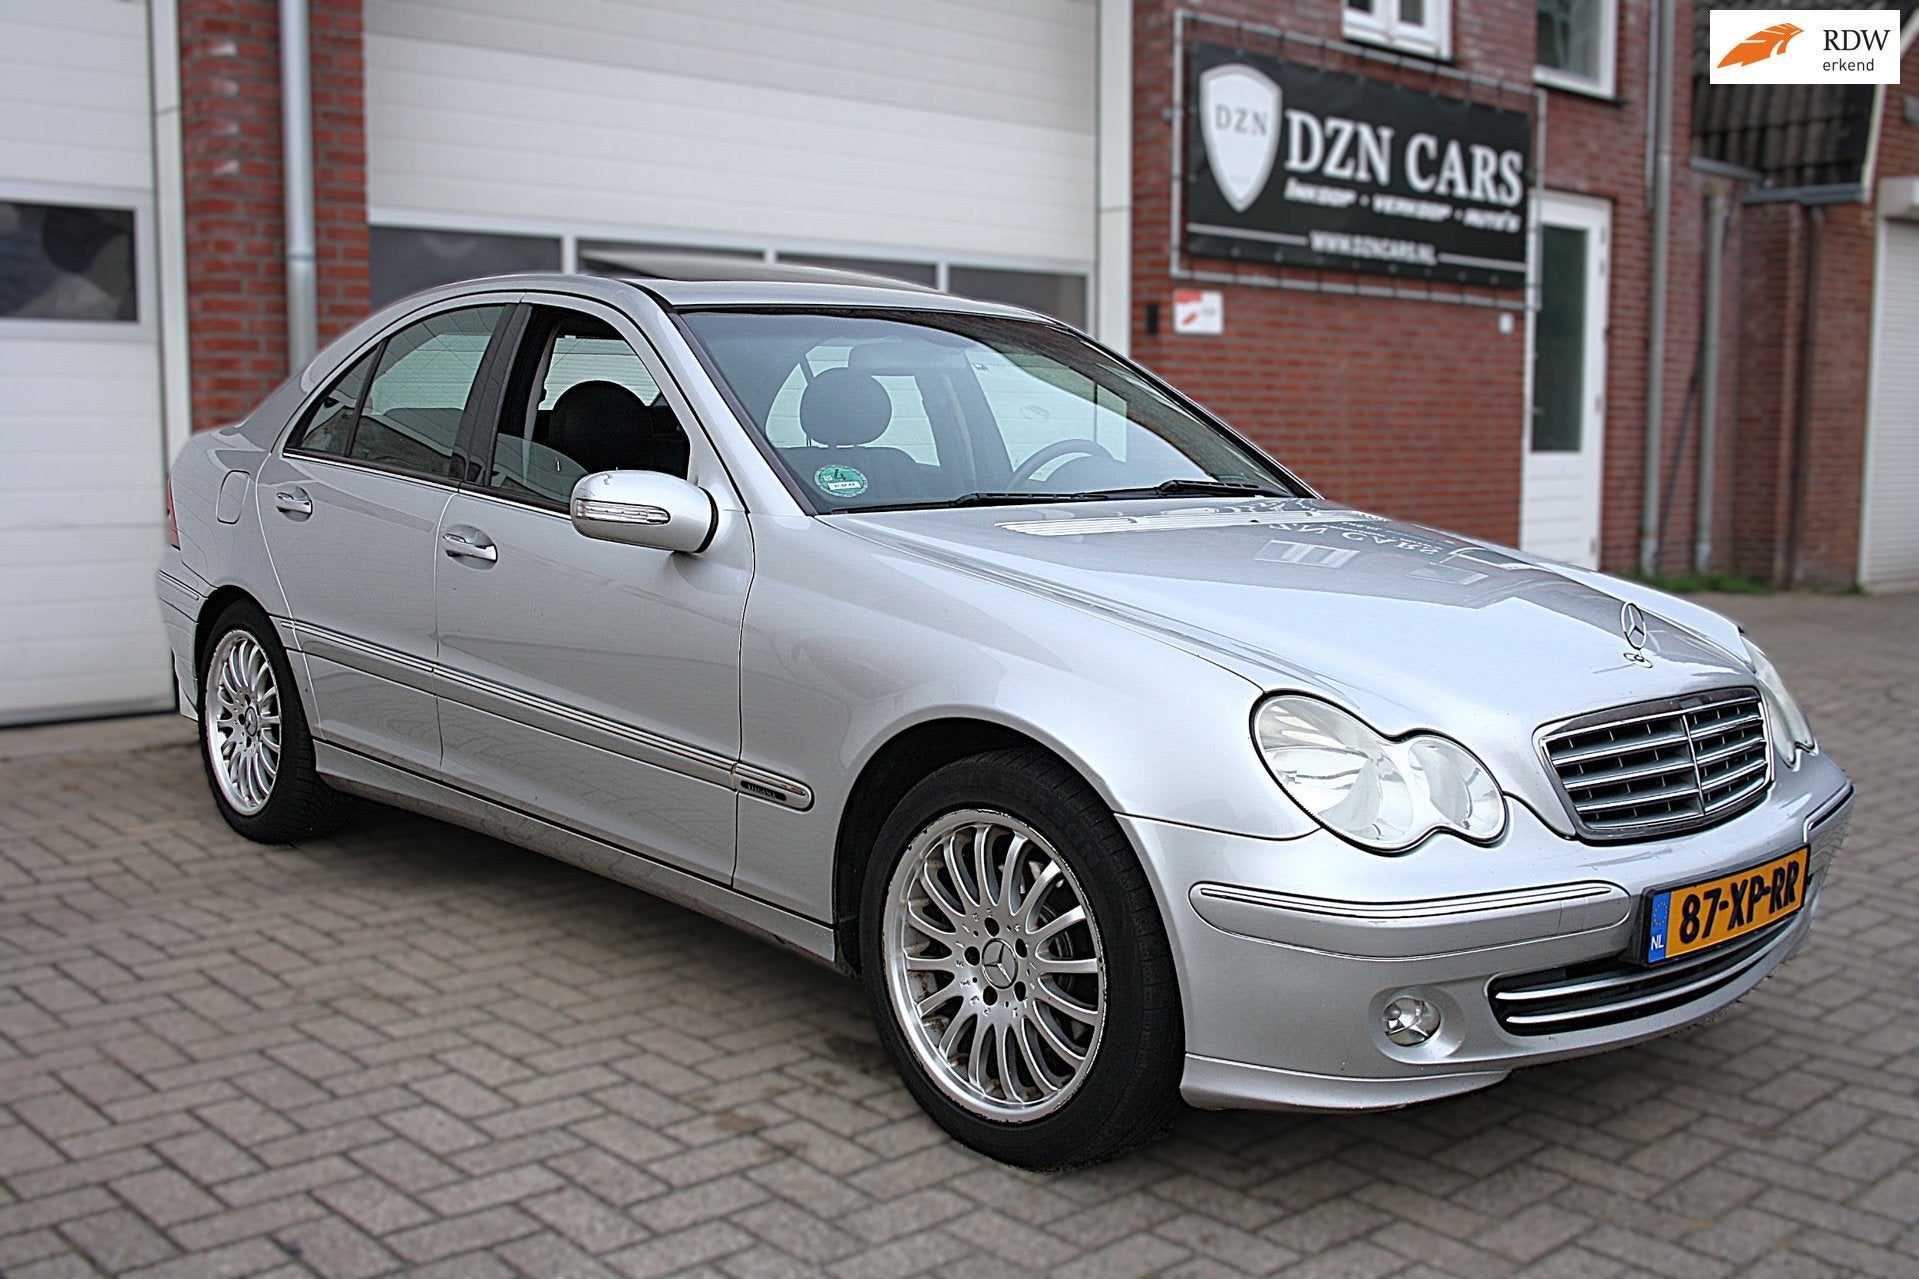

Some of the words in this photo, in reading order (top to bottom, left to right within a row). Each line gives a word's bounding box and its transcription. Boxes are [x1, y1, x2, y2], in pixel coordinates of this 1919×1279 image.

[1215, 103, 1267, 137] DZN
[1284, 109, 1394, 186] DZN
[1404, 132, 1523, 207] CARS
[1679, 860, 1799, 944] 87-XP-RR
[1651, 934, 1664, 950] NL
